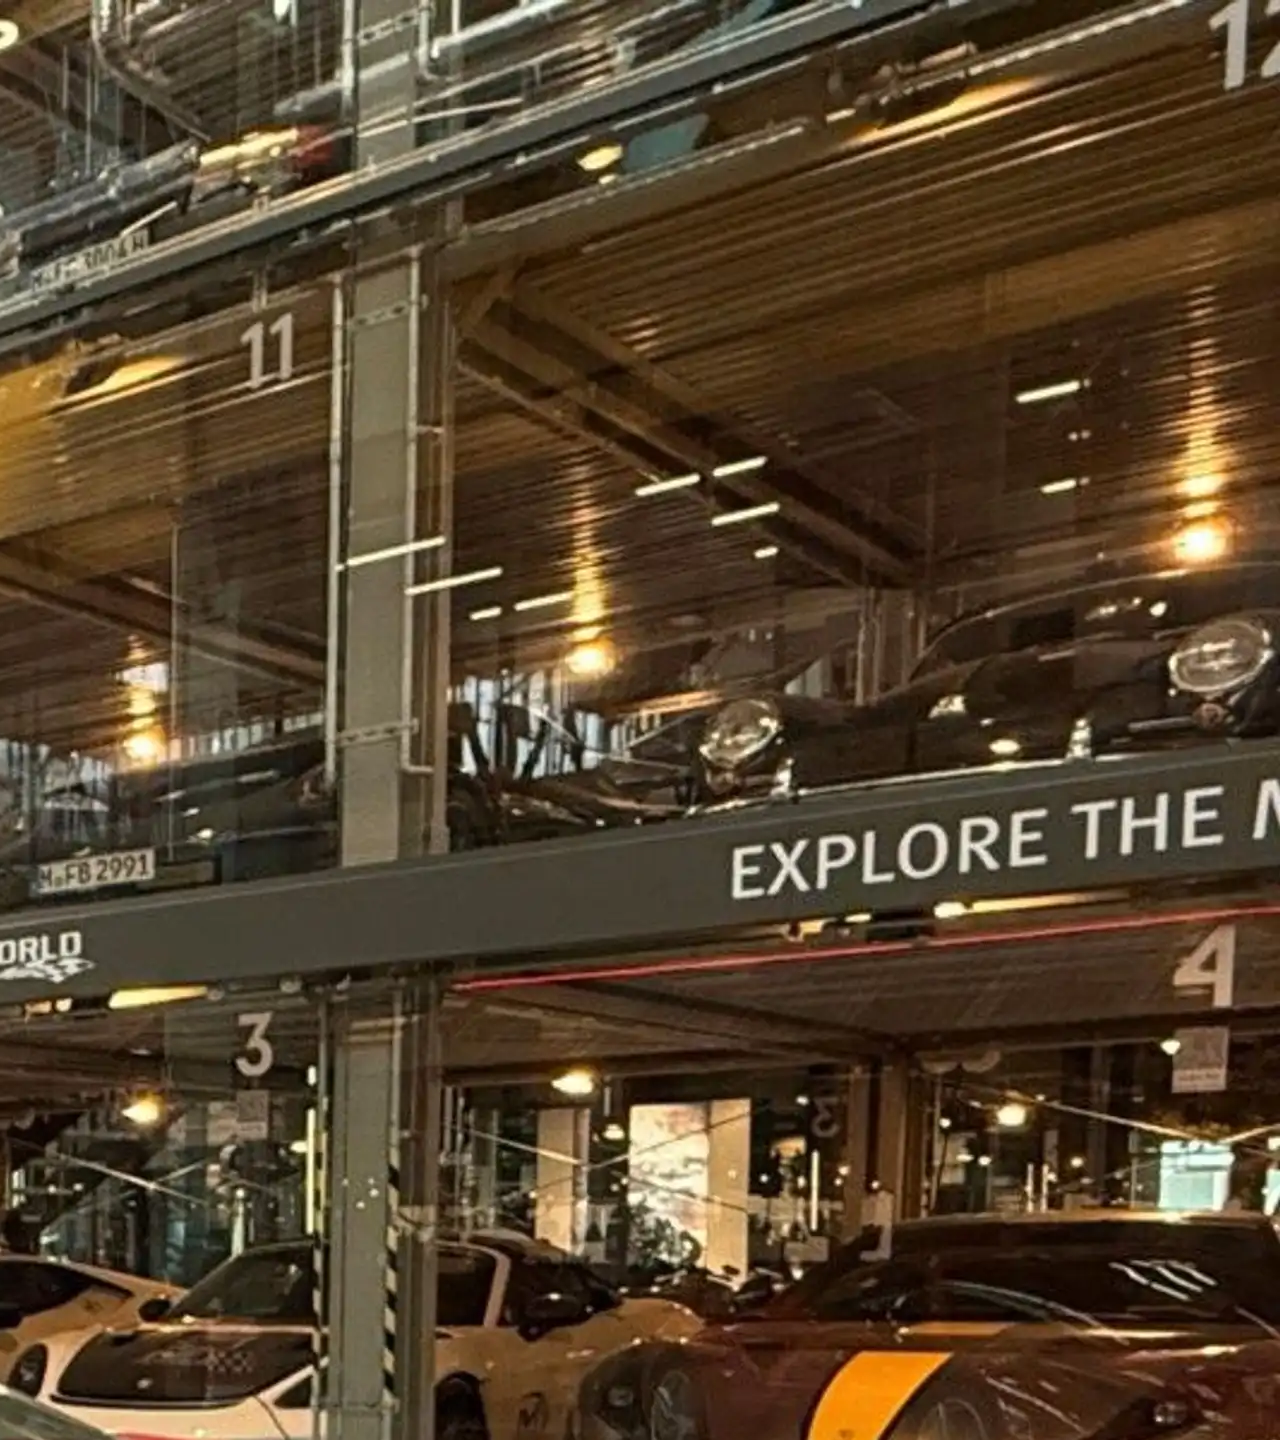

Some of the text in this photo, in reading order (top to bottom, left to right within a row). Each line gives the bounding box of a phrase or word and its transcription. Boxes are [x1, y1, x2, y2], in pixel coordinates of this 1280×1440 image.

[240, 312, 293, 389] 11
[95, 853, 151, 882] 2991
[731, 806, 1048, 900] EXPLORE
[1070, 785, 1225, 860] THE
[1173, 923, 1236, 1007] 4
[235, 1010, 274, 1077] 3
